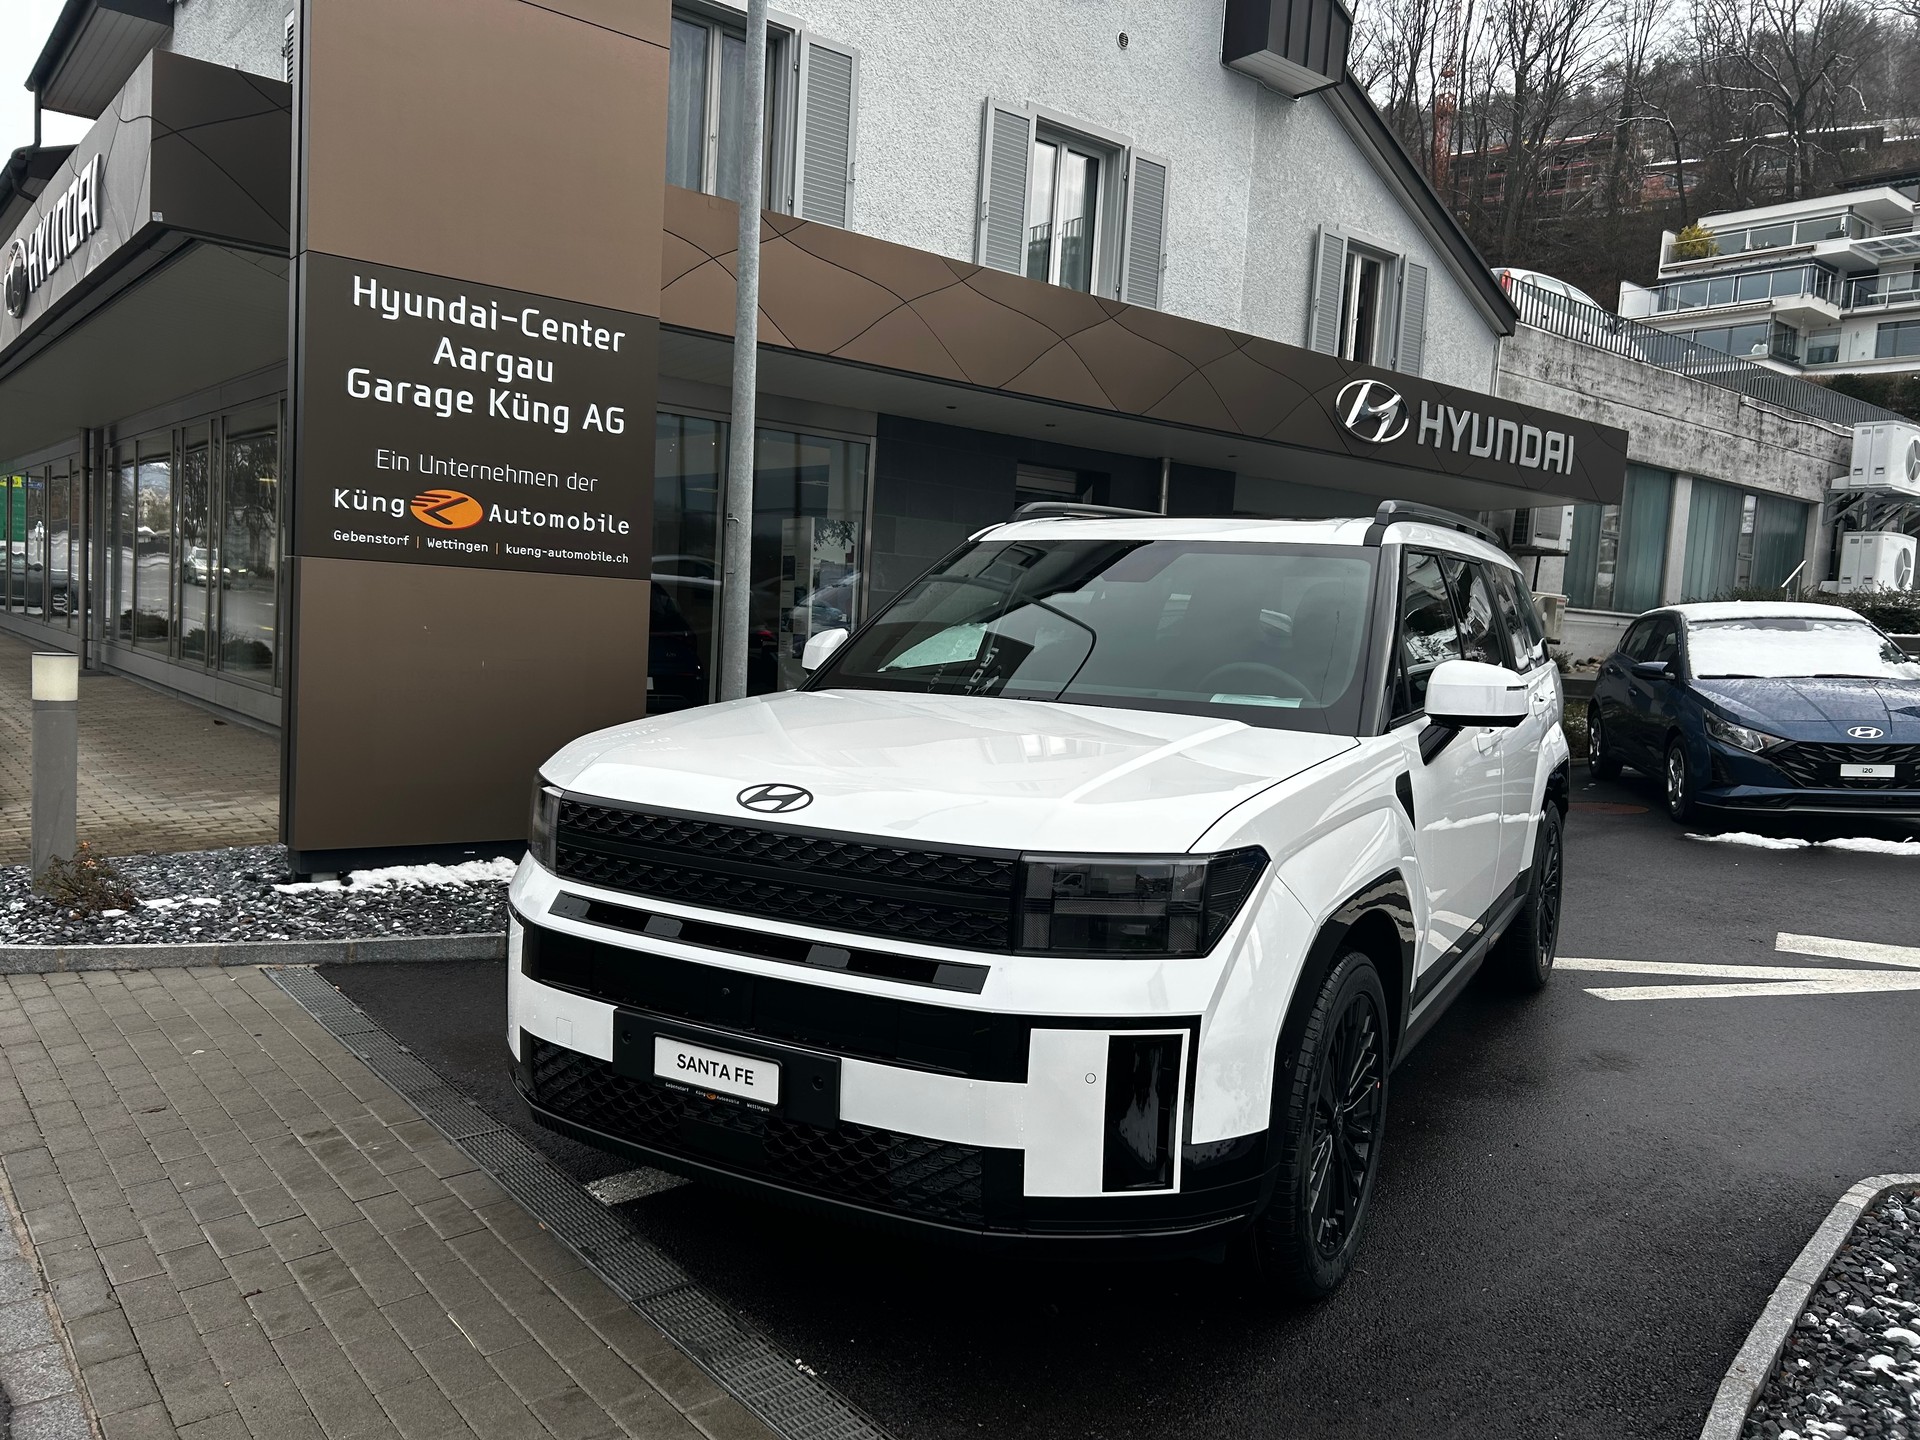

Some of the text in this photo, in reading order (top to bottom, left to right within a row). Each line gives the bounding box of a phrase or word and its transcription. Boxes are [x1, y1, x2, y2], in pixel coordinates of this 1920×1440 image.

[28, 153, 101, 293] HYUNDAI
[353, 275, 626, 352] Hyundai-Center
[433, 336, 554, 383] Aargau
[347, 367, 625, 435] Garage Küng AG
[1417, 400, 1574, 475] HYUNDAI
[376, 448, 598, 492] Ein Unternehmen der
[333, 488, 630, 535] Küng Automobile
[333, 529, 630, 564] Gebenstorf Wettingen kueng-automobile.ch
[676, 1053, 754, 1085] SANTA FE
